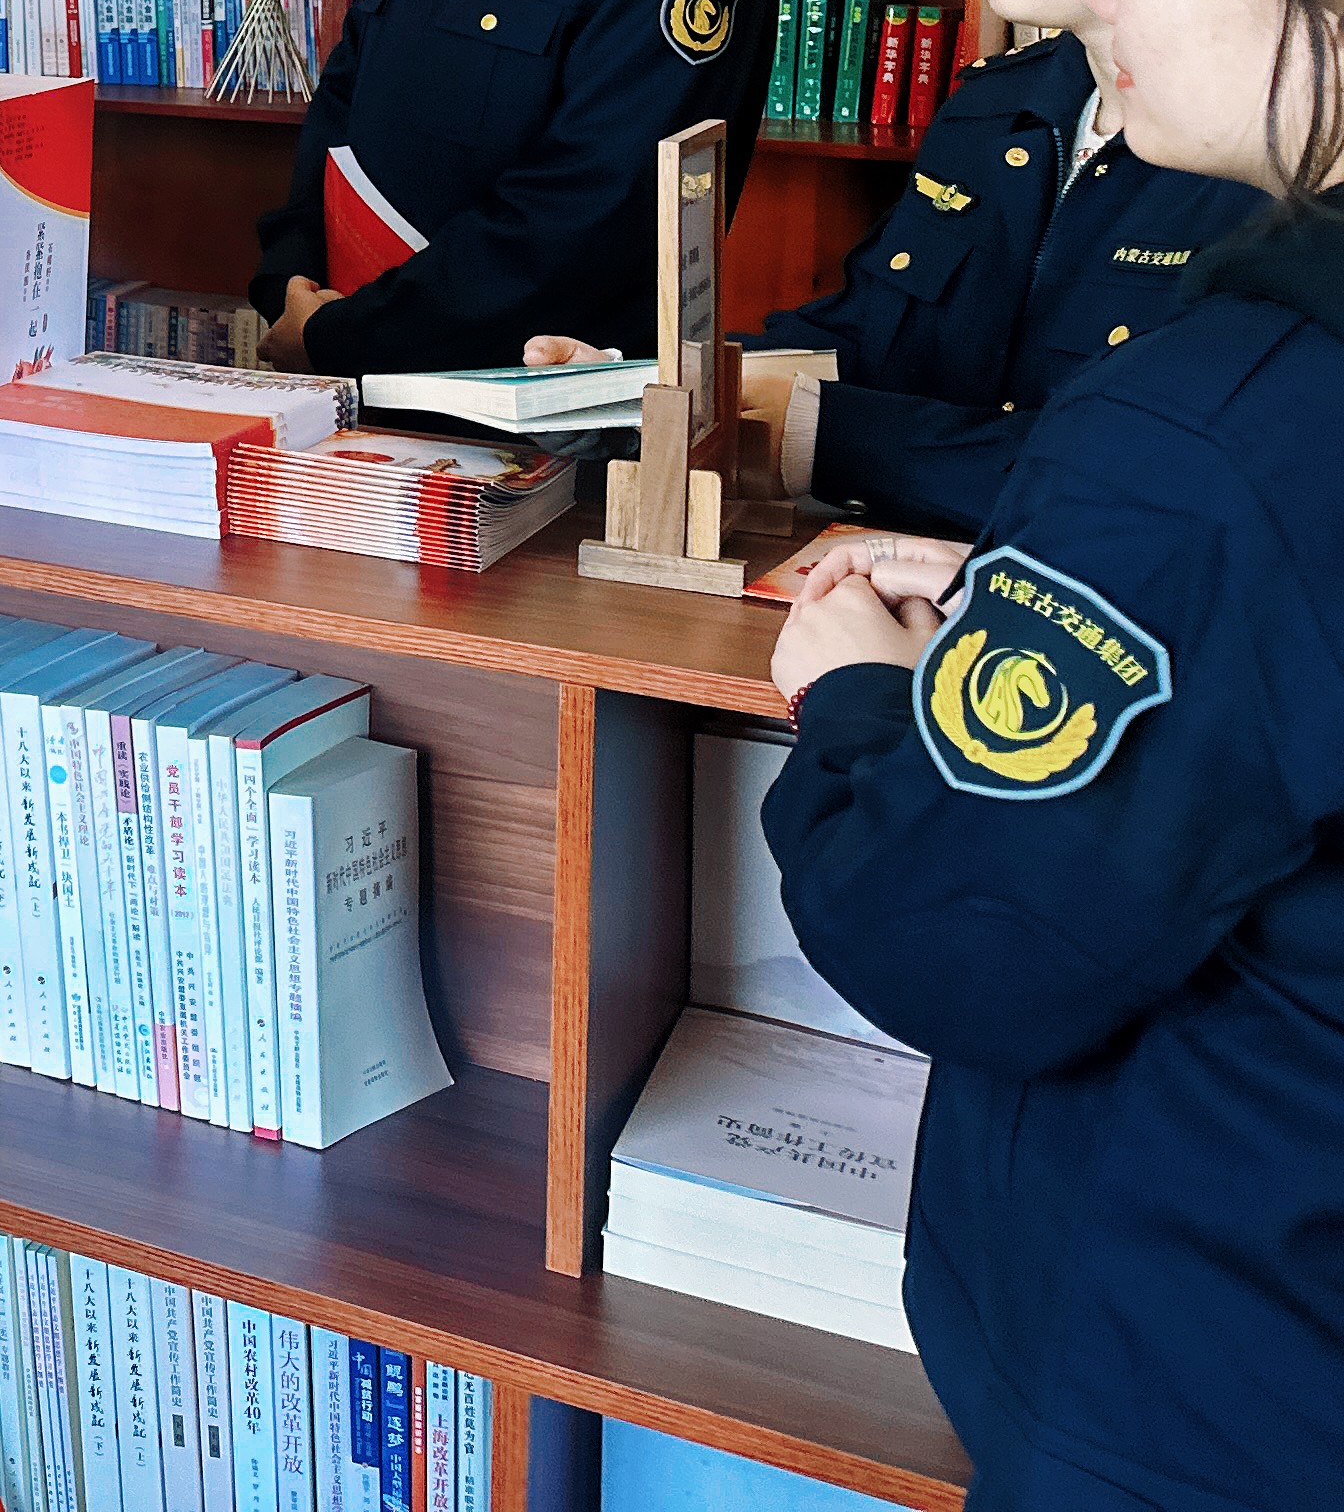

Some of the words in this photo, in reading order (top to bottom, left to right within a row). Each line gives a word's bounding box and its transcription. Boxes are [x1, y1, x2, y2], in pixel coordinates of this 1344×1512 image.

[987, 571, 1149, 688] 内蒙古交通集团
[165, 764, 188, 898] 党员干部学习读本
[200, 1295, 219, 1419] 中国共产党宣传工作简史
[241, 1319, 262, 1435] 中国农村改革40年
[278, 1329, 304, 1476] 伟大的改革开放
